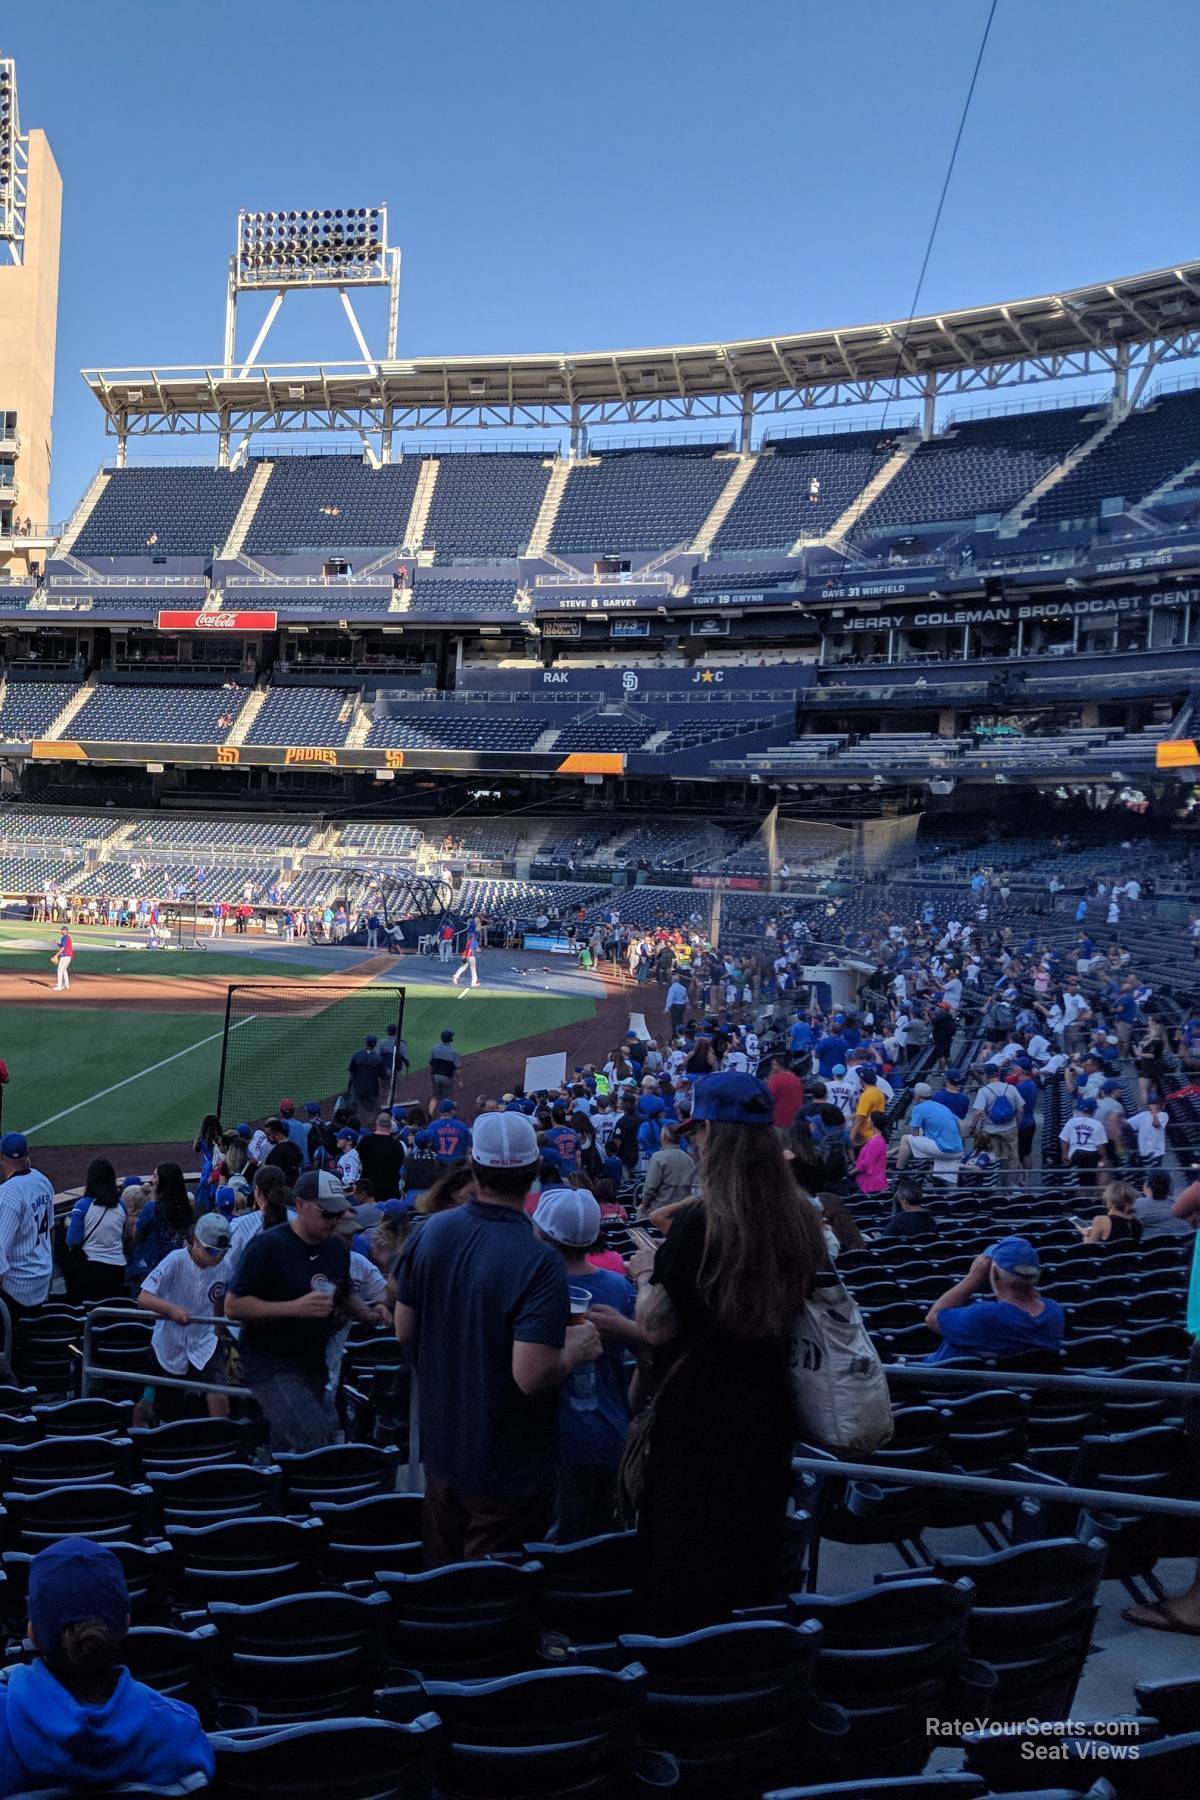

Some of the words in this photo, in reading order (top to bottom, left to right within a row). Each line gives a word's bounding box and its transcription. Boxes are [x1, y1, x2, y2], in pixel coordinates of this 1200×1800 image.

[693, 596, 715, 604] TONY
[718, 594, 730, 604] 19
[732, 594, 764, 603] GWYNN
[822, 589, 845, 598] DAVE
[847, 587, 860, 597] 31
[862, 584, 905, 595] WINFIELD
[560, 600, 587, 608] STEVE
[603, 599, 637, 607] GARVEY
[843, 616, 905, 631] JERRY
[914, 608, 1010, 627] COLEMAN
[1018, 597, 1143, 619] BROADCAST
[543, 672, 569, 683] RAK
[285, 748, 337, 765] PADRES
[833, 1095, 851, 1112] 17
[438, 1136, 459, 1156] 17
[1076, 1131, 1093, 1146] 17
[34, 1206, 49, 1248] 14
